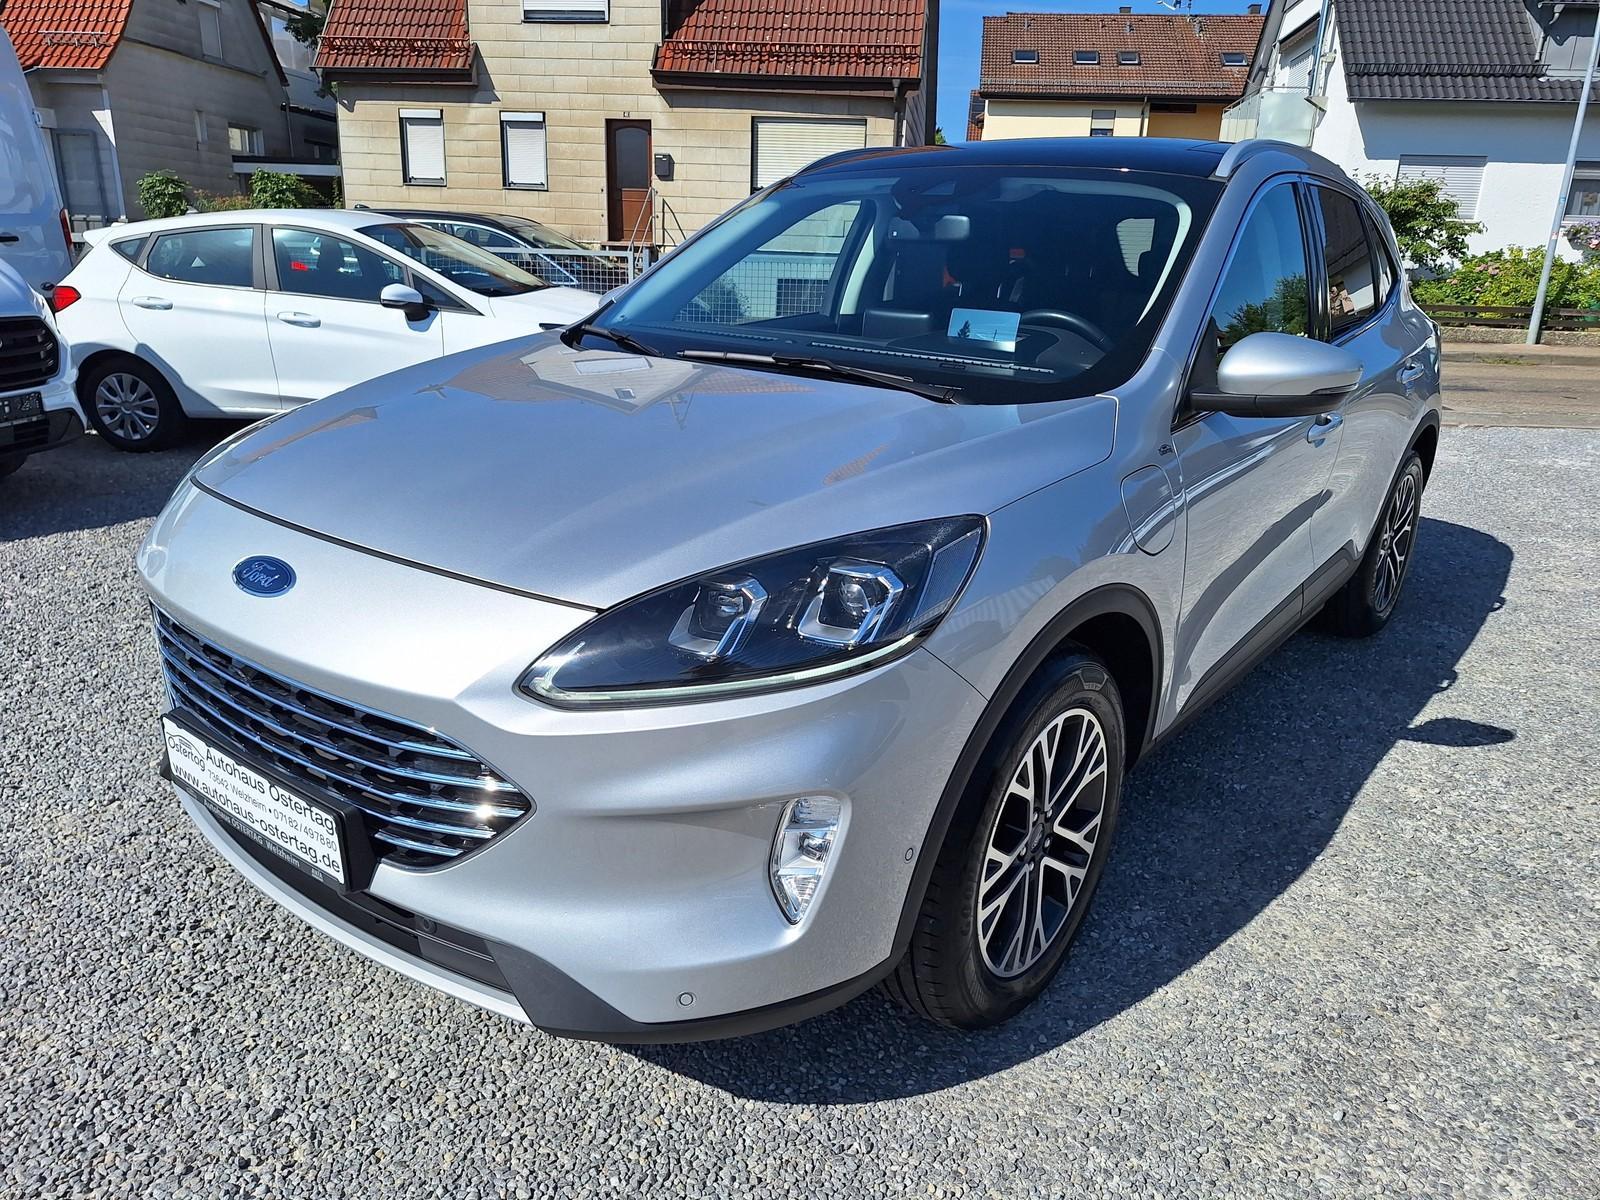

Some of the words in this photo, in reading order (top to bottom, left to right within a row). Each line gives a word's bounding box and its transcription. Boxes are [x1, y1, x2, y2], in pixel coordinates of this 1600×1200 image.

[243, 561, 280, 588] Ford
[168, 736, 206, 772] Ostertag
[206, 748, 265, 794] Autohaus
[269, 785, 335, 836] Ostertag
[207, 768, 229, 791] 73642
[230, 783, 267, 813] Welzheim
[173, 762, 340, 873] www.autohaus-ostertag.de
[266, 840, 300, 867] Welzheim
